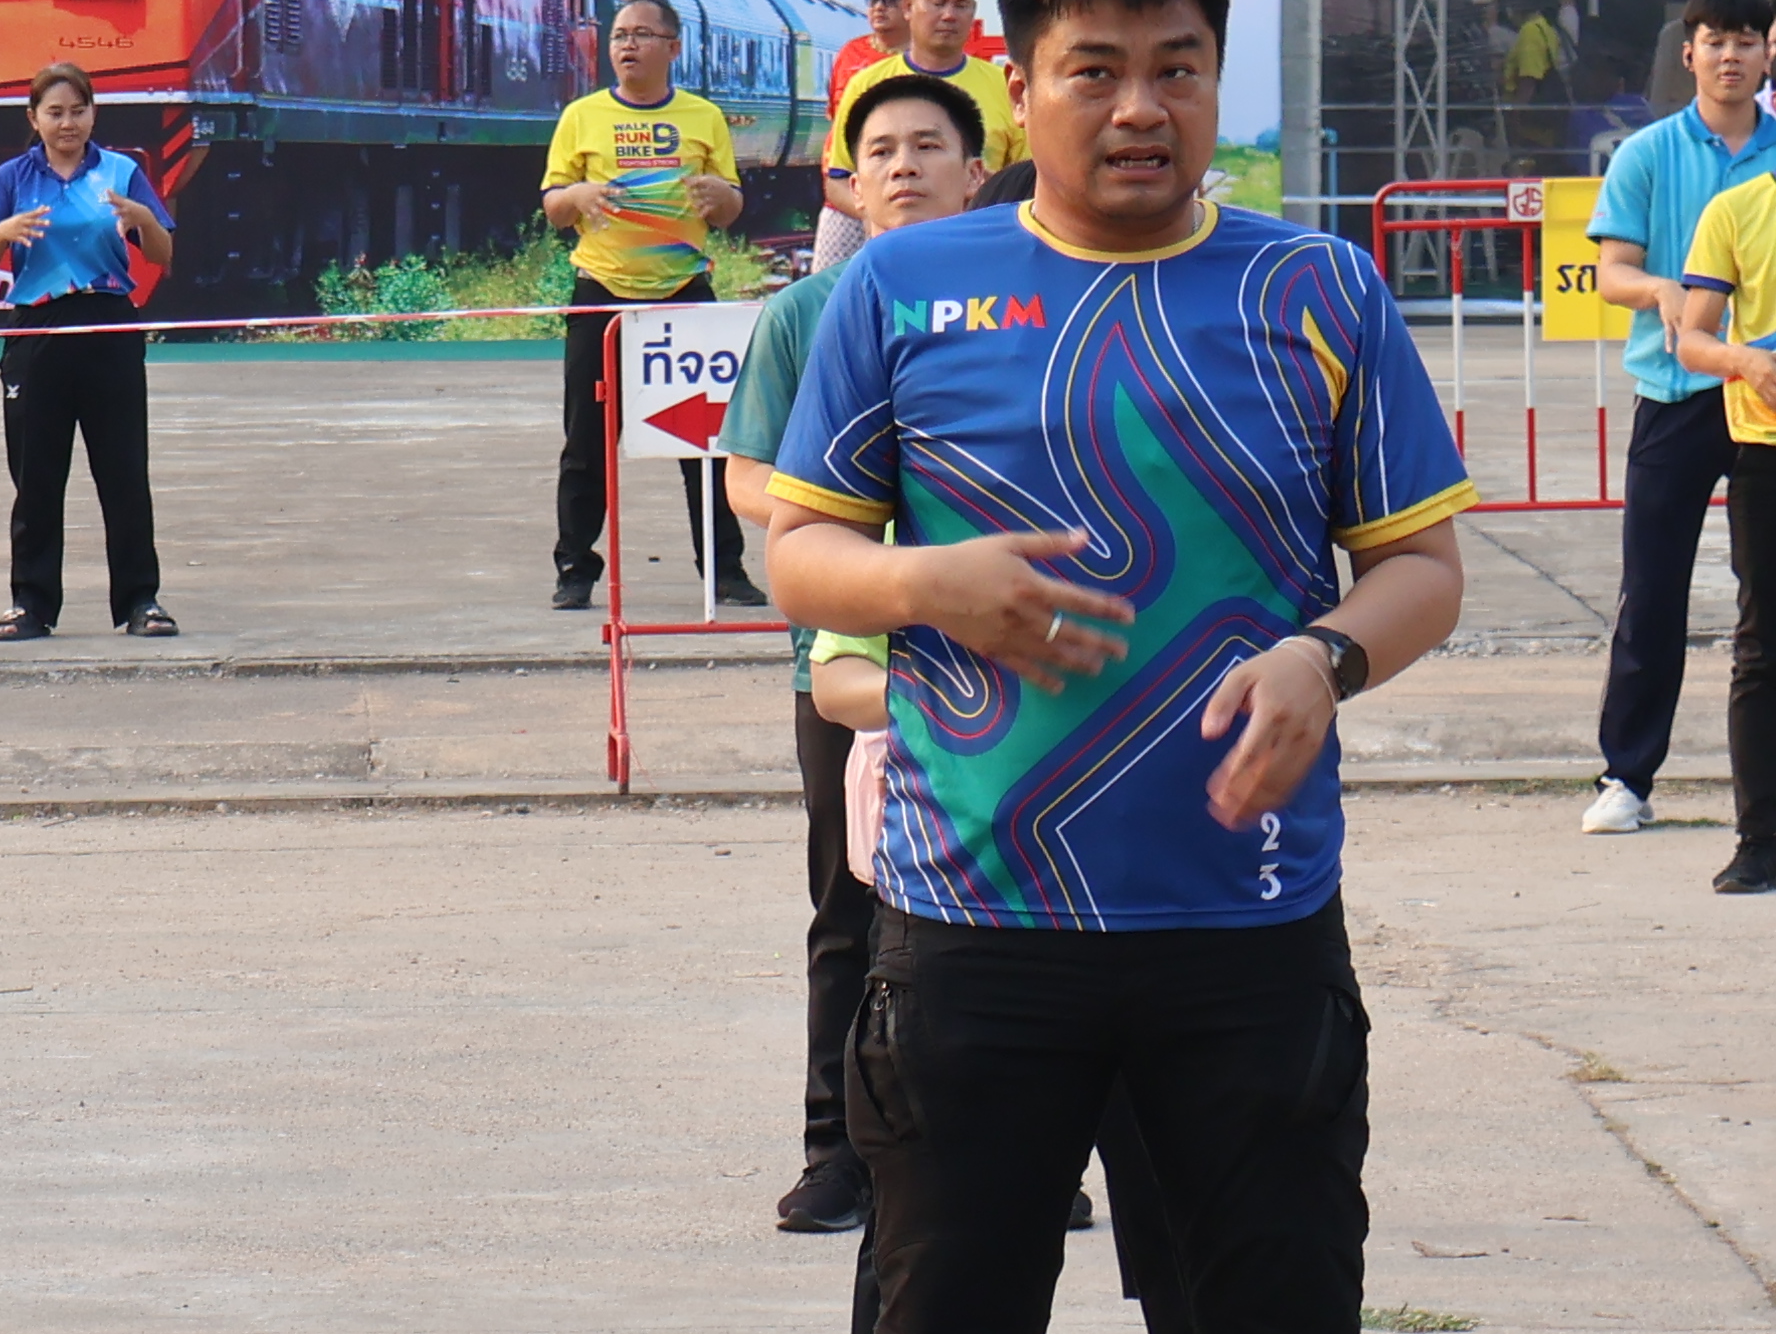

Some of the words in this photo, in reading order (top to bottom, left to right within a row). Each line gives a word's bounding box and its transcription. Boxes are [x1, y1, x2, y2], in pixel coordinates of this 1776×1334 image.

[613, 123, 650, 131] WALK
[614, 132, 651, 143] RUN
[616, 146, 652, 157] BIKE
[893, 293, 1047, 336] NPKM
[642, 322, 740, 385] ที่จอ
